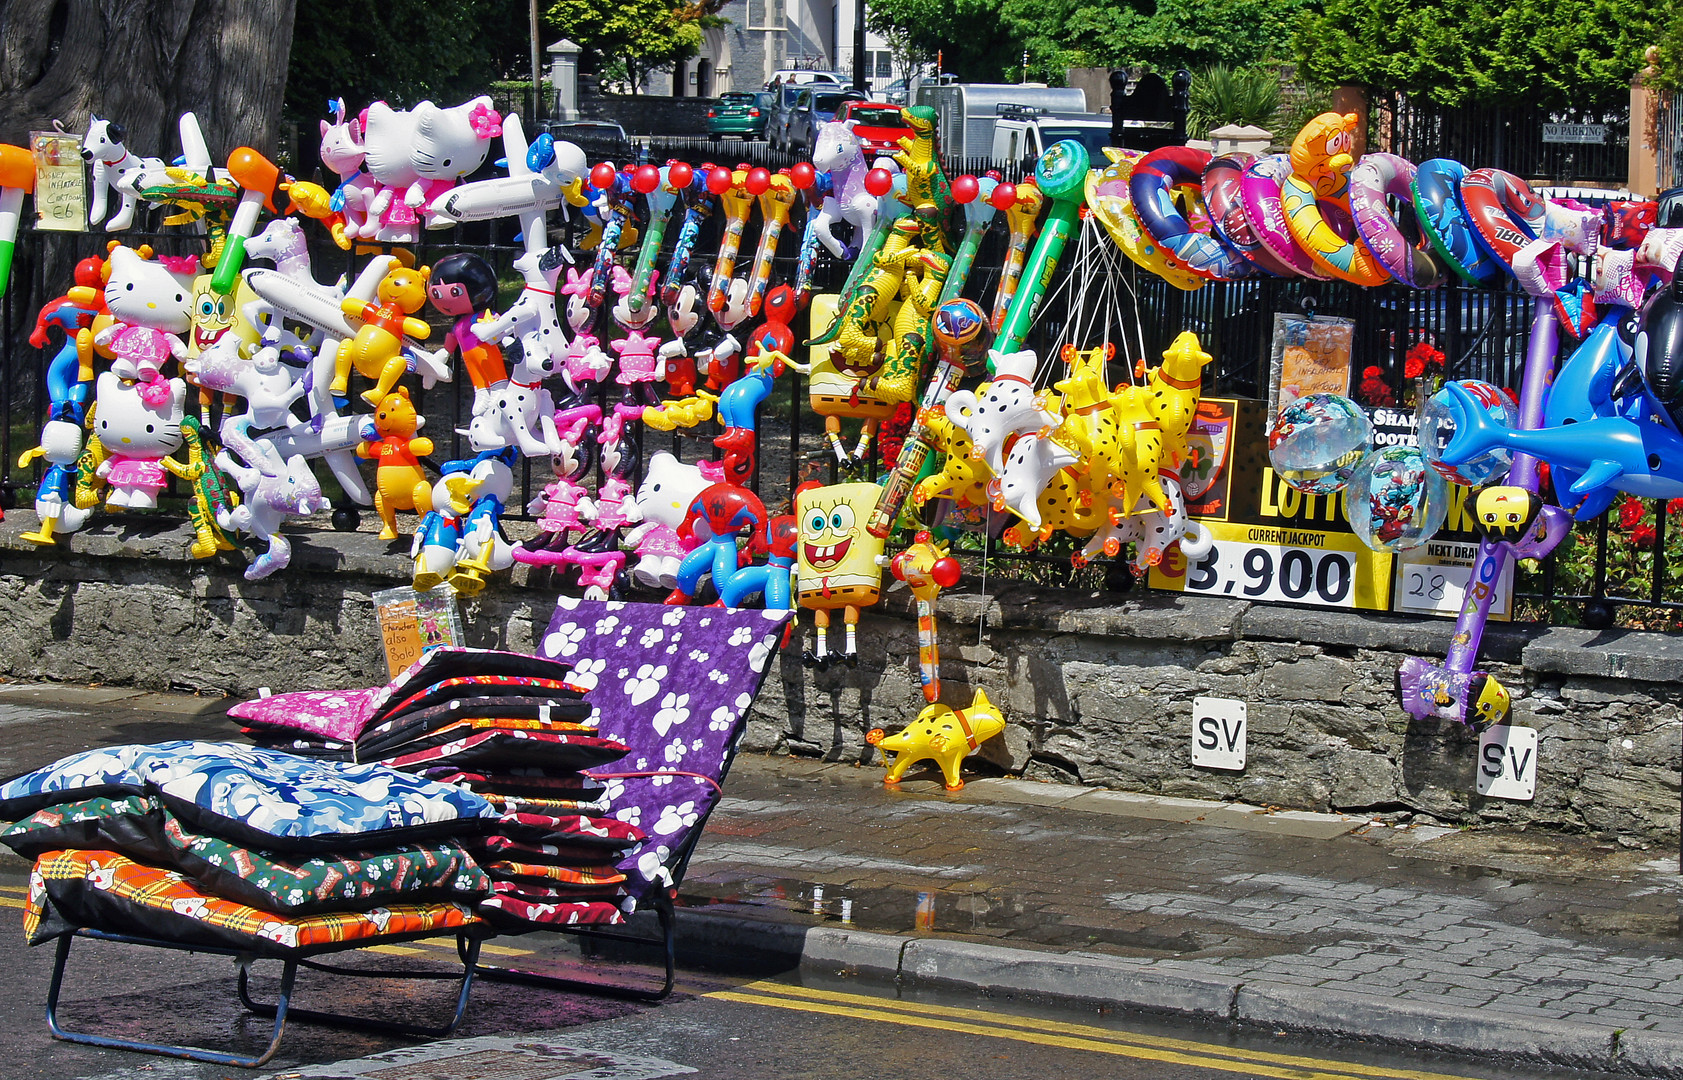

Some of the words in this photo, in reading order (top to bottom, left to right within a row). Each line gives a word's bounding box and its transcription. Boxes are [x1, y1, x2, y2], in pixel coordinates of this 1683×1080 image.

[1545, 126, 1557, 136] NO
[1561, 126, 1601, 136] PARKING
[1039, 255, 1058, 289] BEN
[1248, 528, 1288, 544] CURRENT
[1288, 531, 1326, 547] JACKPOT
[1428, 544, 1452, 557] NEXT
[1408, 572, 1445, 601] 28
[390, 647, 415, 662] Sold
